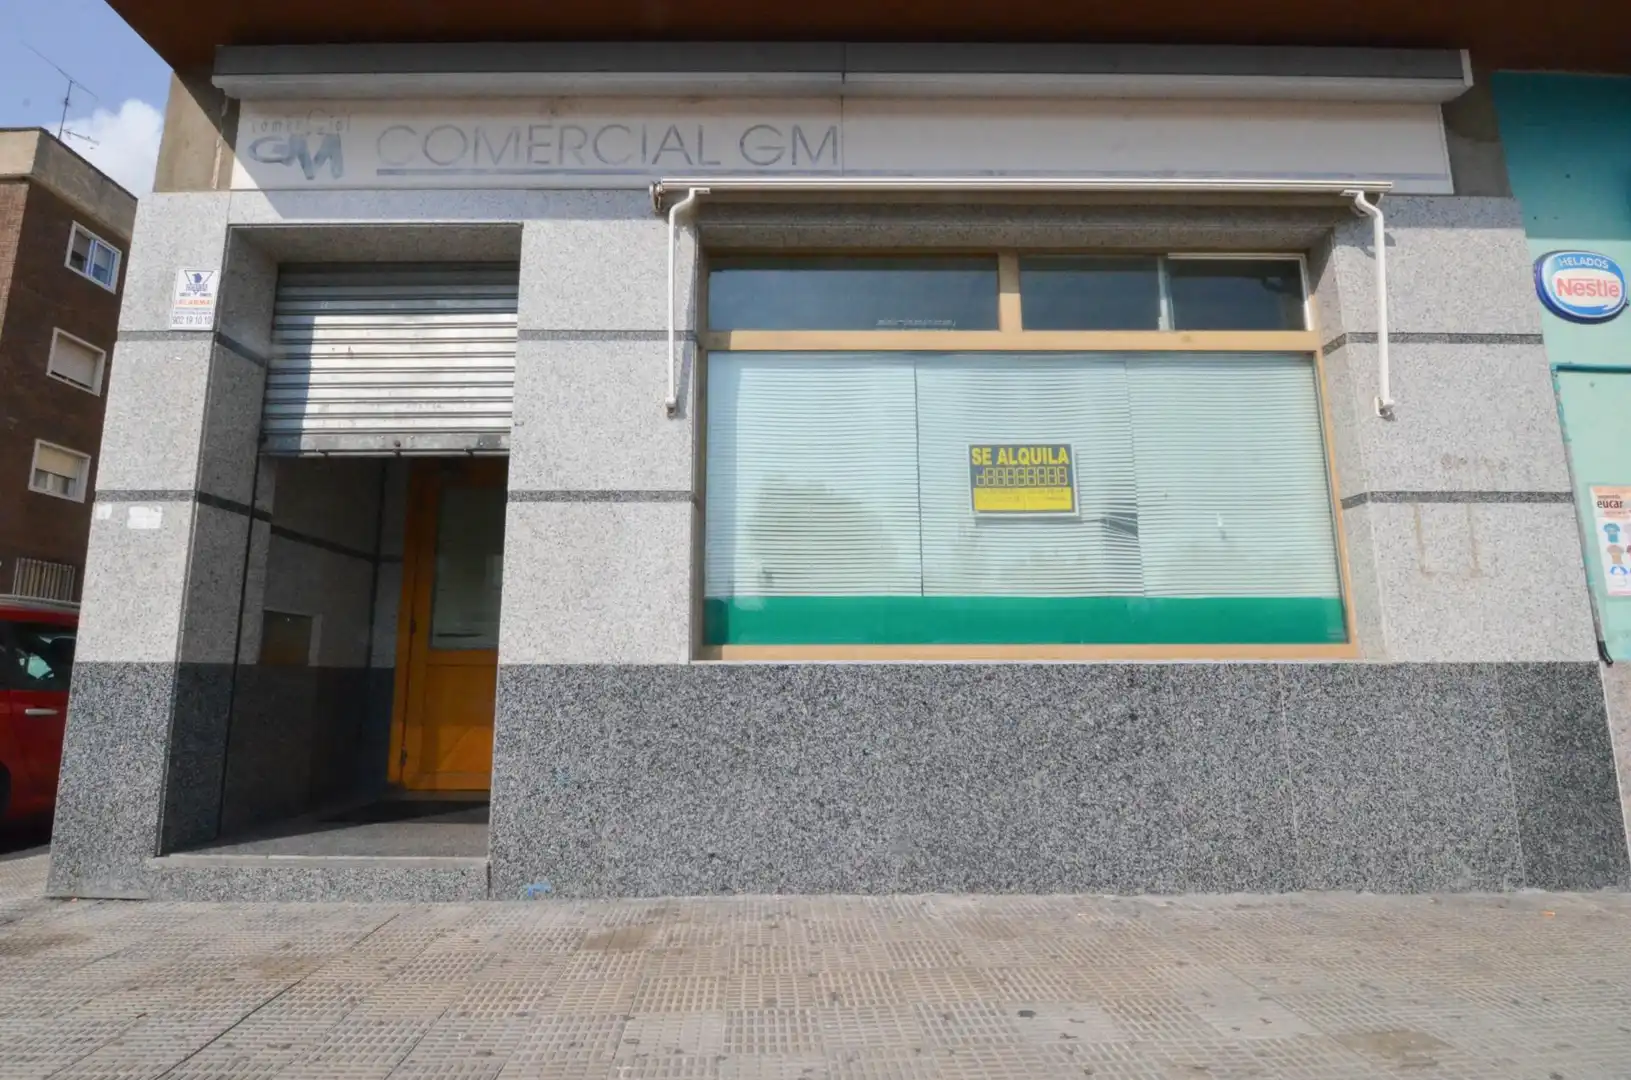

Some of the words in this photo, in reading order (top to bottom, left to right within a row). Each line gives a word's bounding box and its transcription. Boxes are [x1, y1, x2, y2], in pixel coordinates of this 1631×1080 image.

[376, 123, 721, 167] COMERCIAL
[738, 123, 838, 167] GM
[1560, 257, 1609, 269] HELADOS
[971, 447, 993, 465] SE
[996, 447, 1070, 465] ALQUILA
